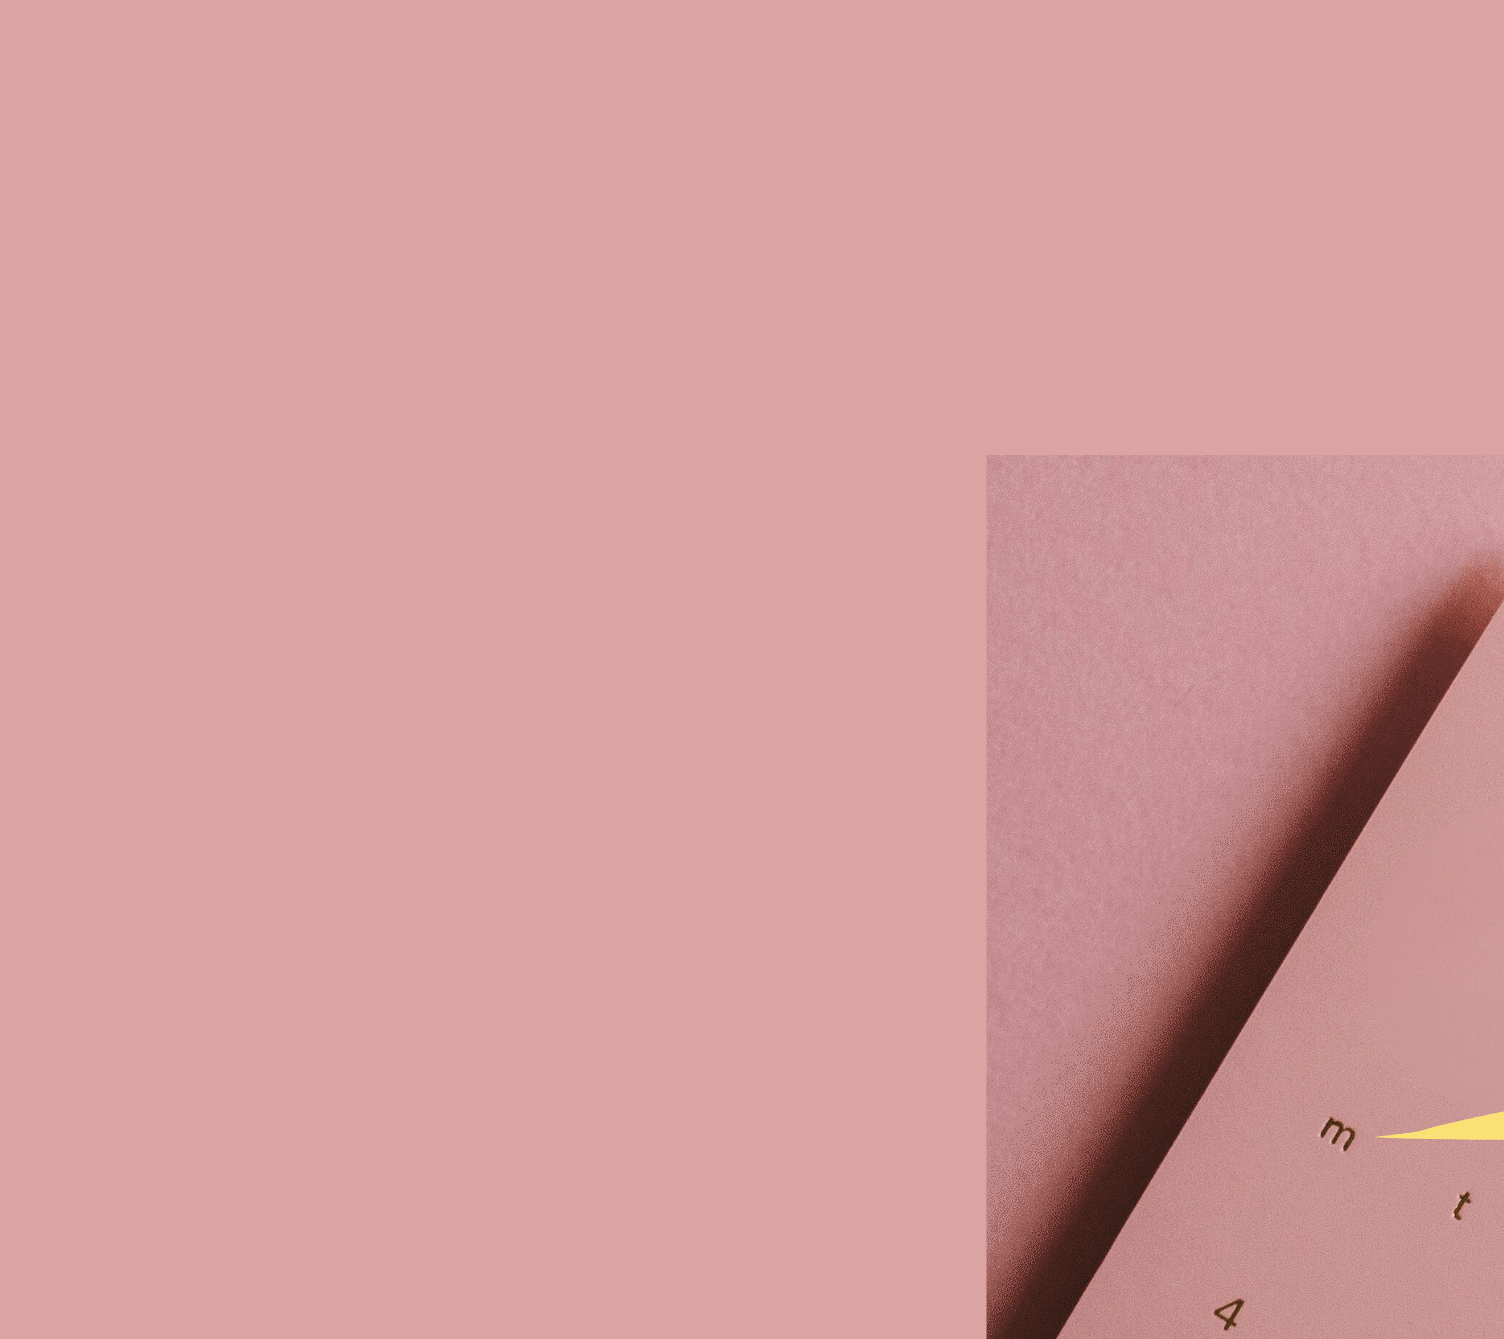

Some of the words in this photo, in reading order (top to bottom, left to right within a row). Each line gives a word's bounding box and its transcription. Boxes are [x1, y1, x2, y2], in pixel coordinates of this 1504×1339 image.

[1321, 1118, 1355, 1151] m
[1454, 1192, 1471, 1220] t
[1214, 1299, 1244, 1330] 4
